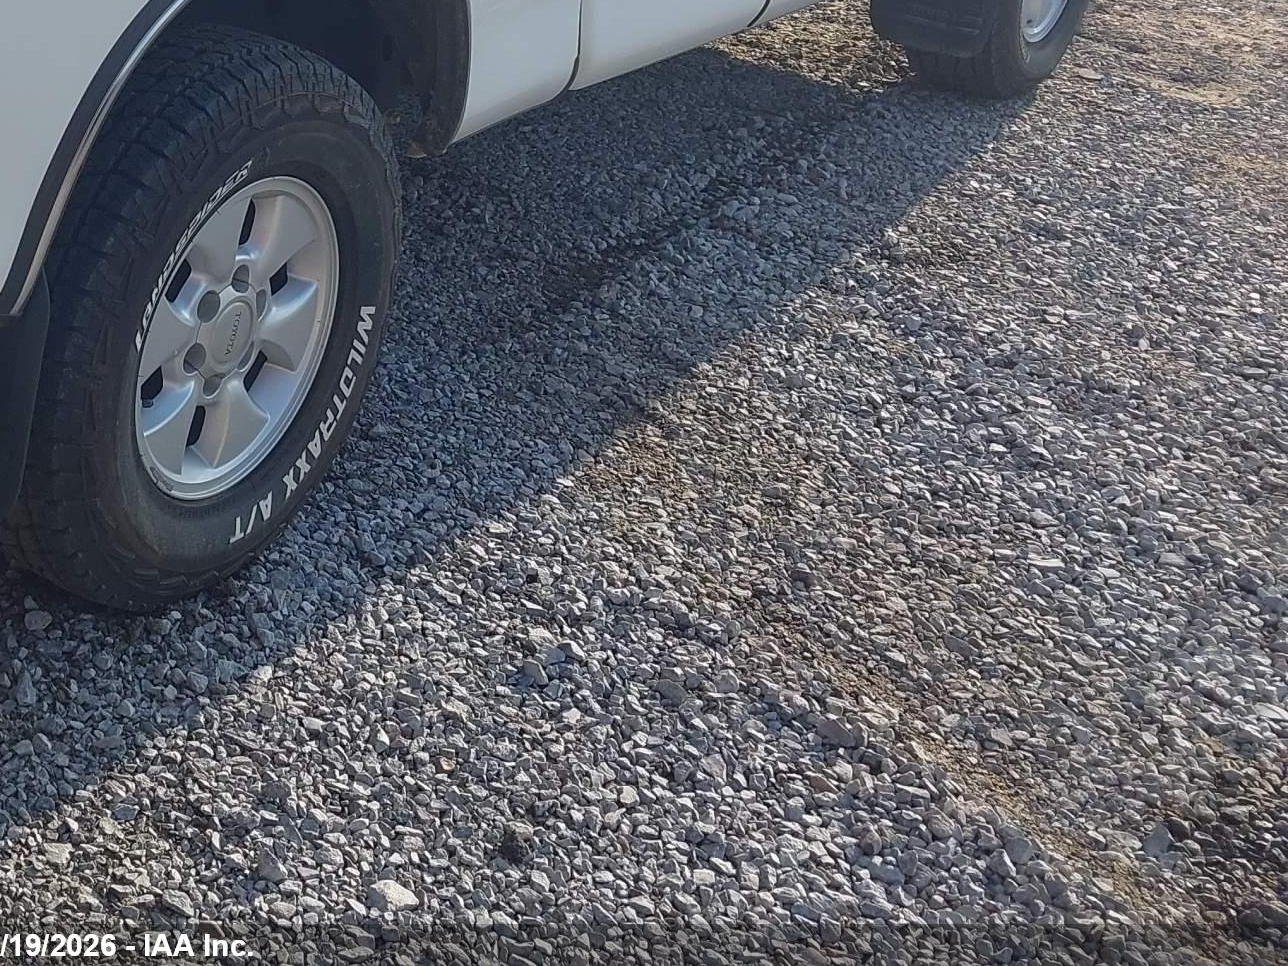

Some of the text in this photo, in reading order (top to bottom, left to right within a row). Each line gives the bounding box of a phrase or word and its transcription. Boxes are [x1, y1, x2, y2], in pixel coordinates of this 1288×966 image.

[224, 310, 243, 356] TOYOTA
[229, 305, 377, 544] WILDTRAXX A/T
